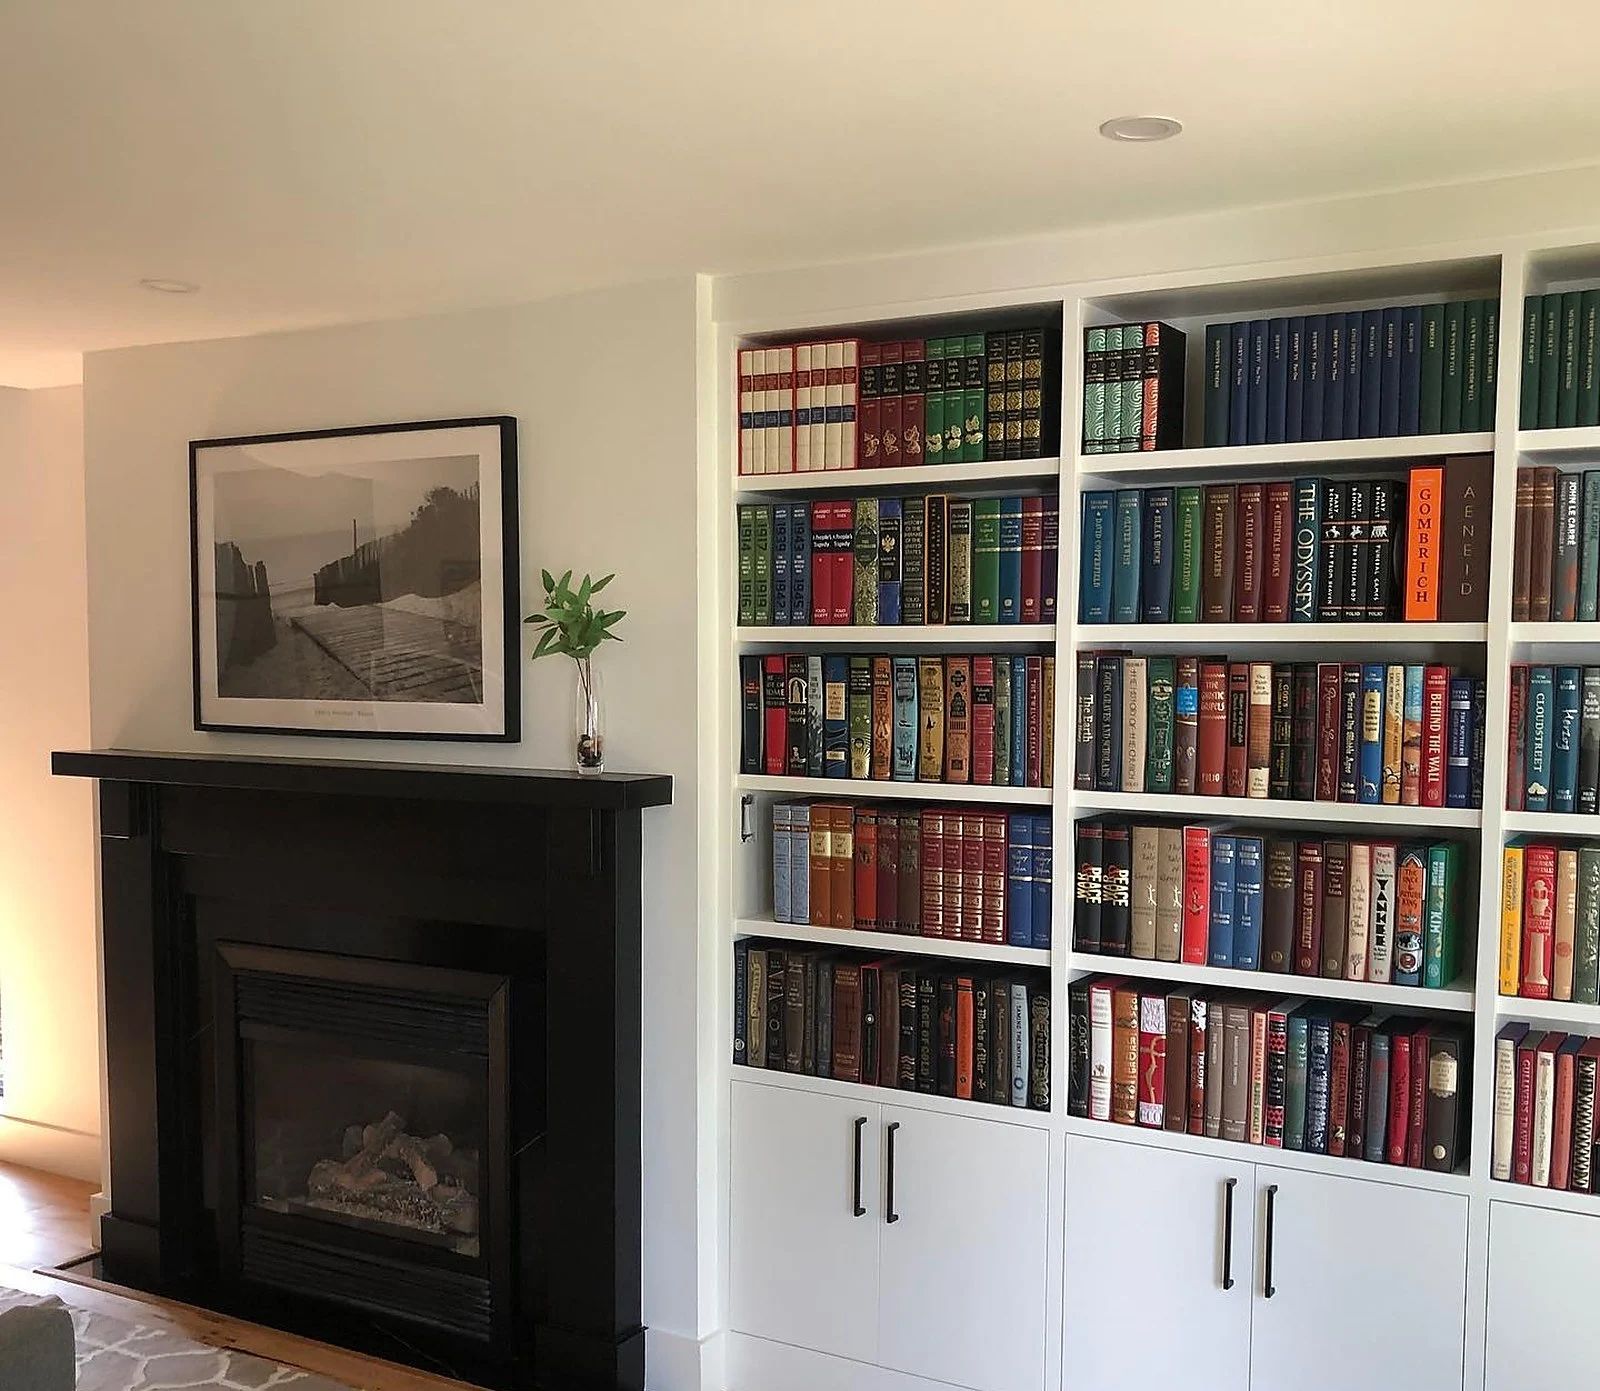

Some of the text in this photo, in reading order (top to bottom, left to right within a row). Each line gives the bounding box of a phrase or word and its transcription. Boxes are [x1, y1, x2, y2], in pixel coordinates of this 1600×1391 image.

[1245, 518, 1253, 537] TALE
[1567, 481, 1577, 546] JOHN LE CARRÉ
[741, 523, 752, 552] 1914
[756, 523, 768, 551] 1917
[1092, 518, 1102, 588] DAVID COPPERFIELD
[1122, 516, 1132, 566] OLIVER TWIST
[1152, 516, 1162, 565] BLEAK HOUSE
[1182, 514, 1192, 591] GREAT EXPECTATIONS
[1213, 513, 1222, 577] PICKWICK PAPERS
[1245, 538, 1253, 547] OF
[1272, 510, 1282, 577] CHRISTMAS BOOKS
[1295, 483, 1316, 618] THE ODYSSEY
[1416, 488, 1431, 602] GOMBRICH
[1460, 486, 1475, 595] AENEID
[1244, 550, 1252, 566] TWO
[742, 579, 752, 607] 1916
[756, 579, 768, 607] 1918
[775, 580, 786, 608] 1942
[794, 579, 805, 609] 1945
[1243, 567, 1252, 591] CITIES
[1082, 694, 1094, 742] The Earth
[1346, 692, 1356, 712] Paris
[1100, 694, 1112, 777] GRAVES AND SCHOLARS
[1342, 720, 1355, 730] the
[1345, 731, 1355, 754] Middle
[1427, 693, 1442, 783] BEHIND THE WALL
[1458, 725, 1466, 756] SOUTHERN
[1533, 692, 1545, 773] CLOUDSTREET
[1556, 709, 1578, 751] Herzog
[1344, 755, 1354, 774] Ages
[1091, 866, 1102, 904] PEACE
[1118, 868, 1129, 907] PEACE
[1505, 897, 1512, 912] OZ
[1302, 869, 1314, 949] CRIME AND PUNISHMENT
[1376, 878, 1389, 947] YANKEE
[1430, 910, 1442, 934] KIM
[974, 990, 987, 1074] The Monks of War
[1078, 1014, 1089, 1060] COURT
[1256, 1018, 1264, 1042] BRAVE
[921, 1045, 930, 1076] GOLD
[1254, 1057, 1262, 1082] WORLD
[1354, 1041, 1365, 1119] THE NORSE MYTHS
[1337, 1065, 1346, 1120] GILGAMESH
[1414, 1078, 1422, 1097] VITA
[1519, 1115, 1528, 1156] TRAVELS
